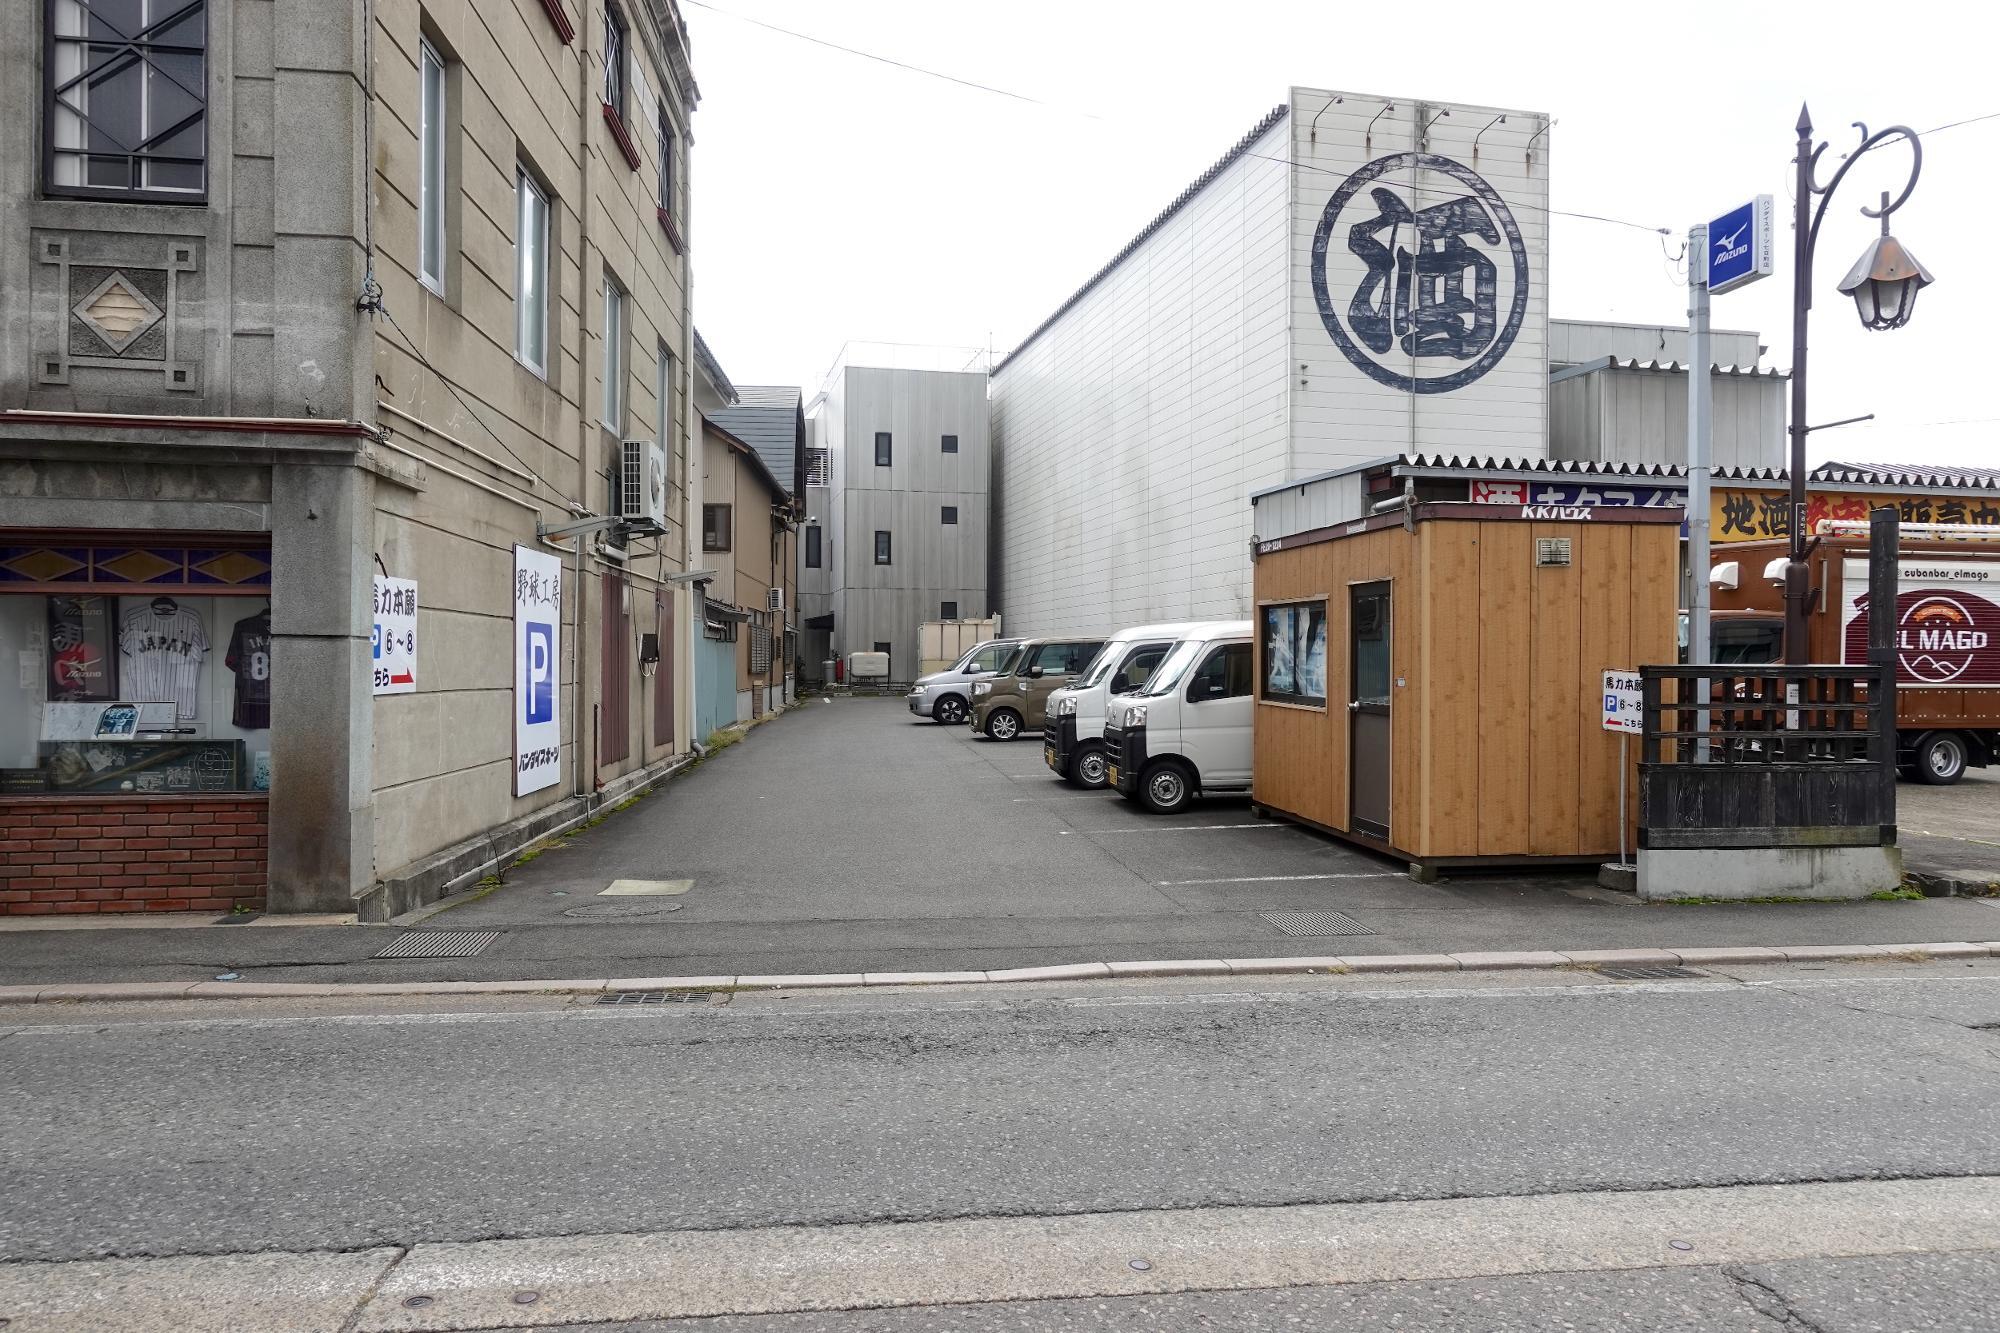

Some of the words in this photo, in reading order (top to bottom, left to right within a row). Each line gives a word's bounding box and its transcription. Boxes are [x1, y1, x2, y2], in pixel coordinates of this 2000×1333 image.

[1521, 505, 1592, 520] KKハウス
[1904, 568, 1989, 582] cubanbar_elmago
[517, 568, 560, 613] 野球工房
[138, 635, 192, 657] JAPAN
[374, 668, 390, 688] ちら
[530, 631, 548, 715] P
[1607, 697, 1616, 710] P
[1624, 718, 1643, 729] こちら
